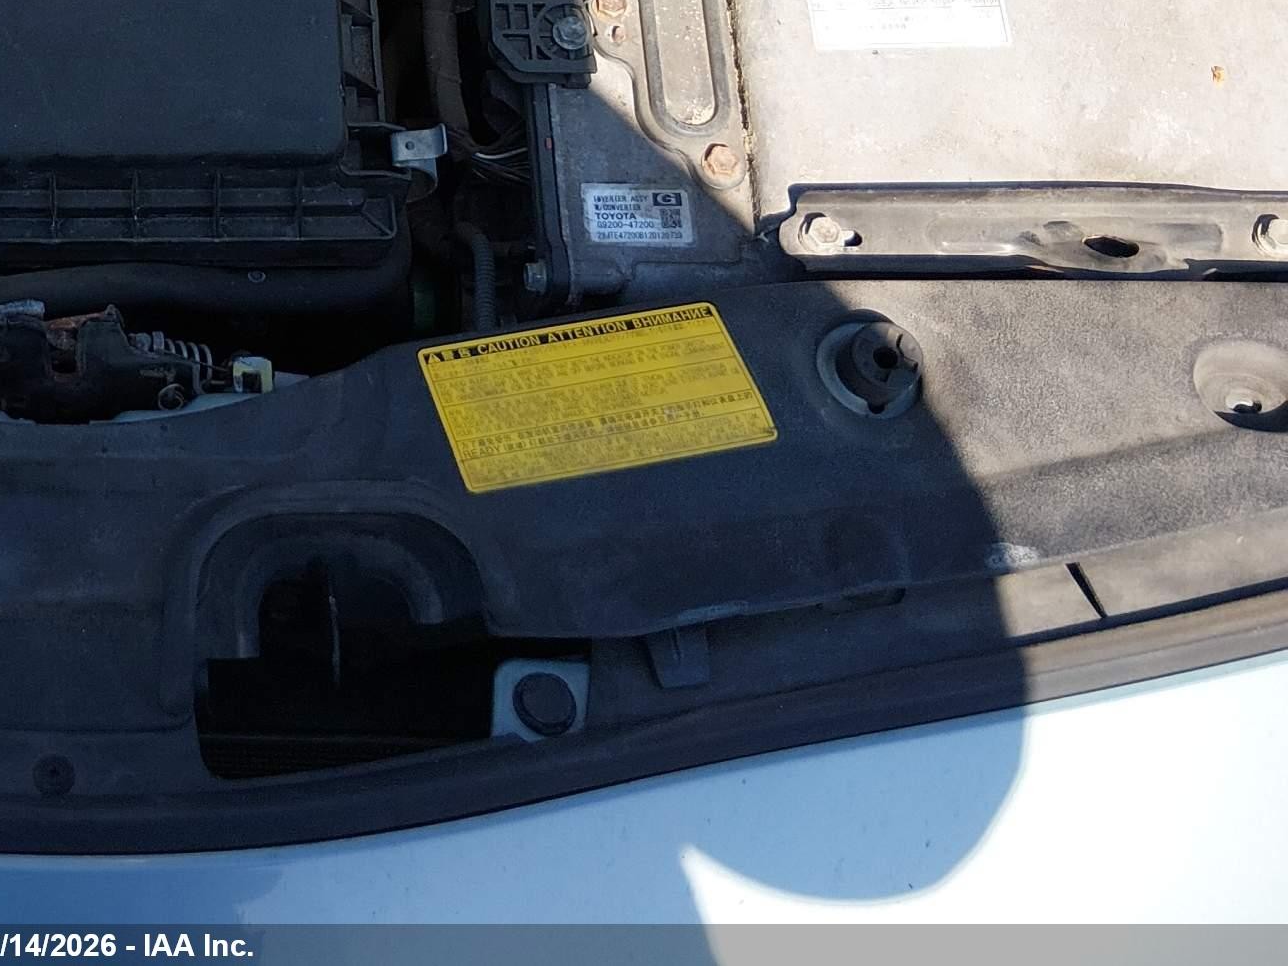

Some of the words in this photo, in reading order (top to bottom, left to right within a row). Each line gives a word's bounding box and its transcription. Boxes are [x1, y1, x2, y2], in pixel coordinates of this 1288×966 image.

[594, 212, 637, 220] TOYOTA
[596, 220, 655, 229] G9200-47200
[477, 335, 542, 355] CAUTION
[548, 322, 628, 344] ATTENTION
[632, 306, 712, 329] ВНИМАНИЕ
